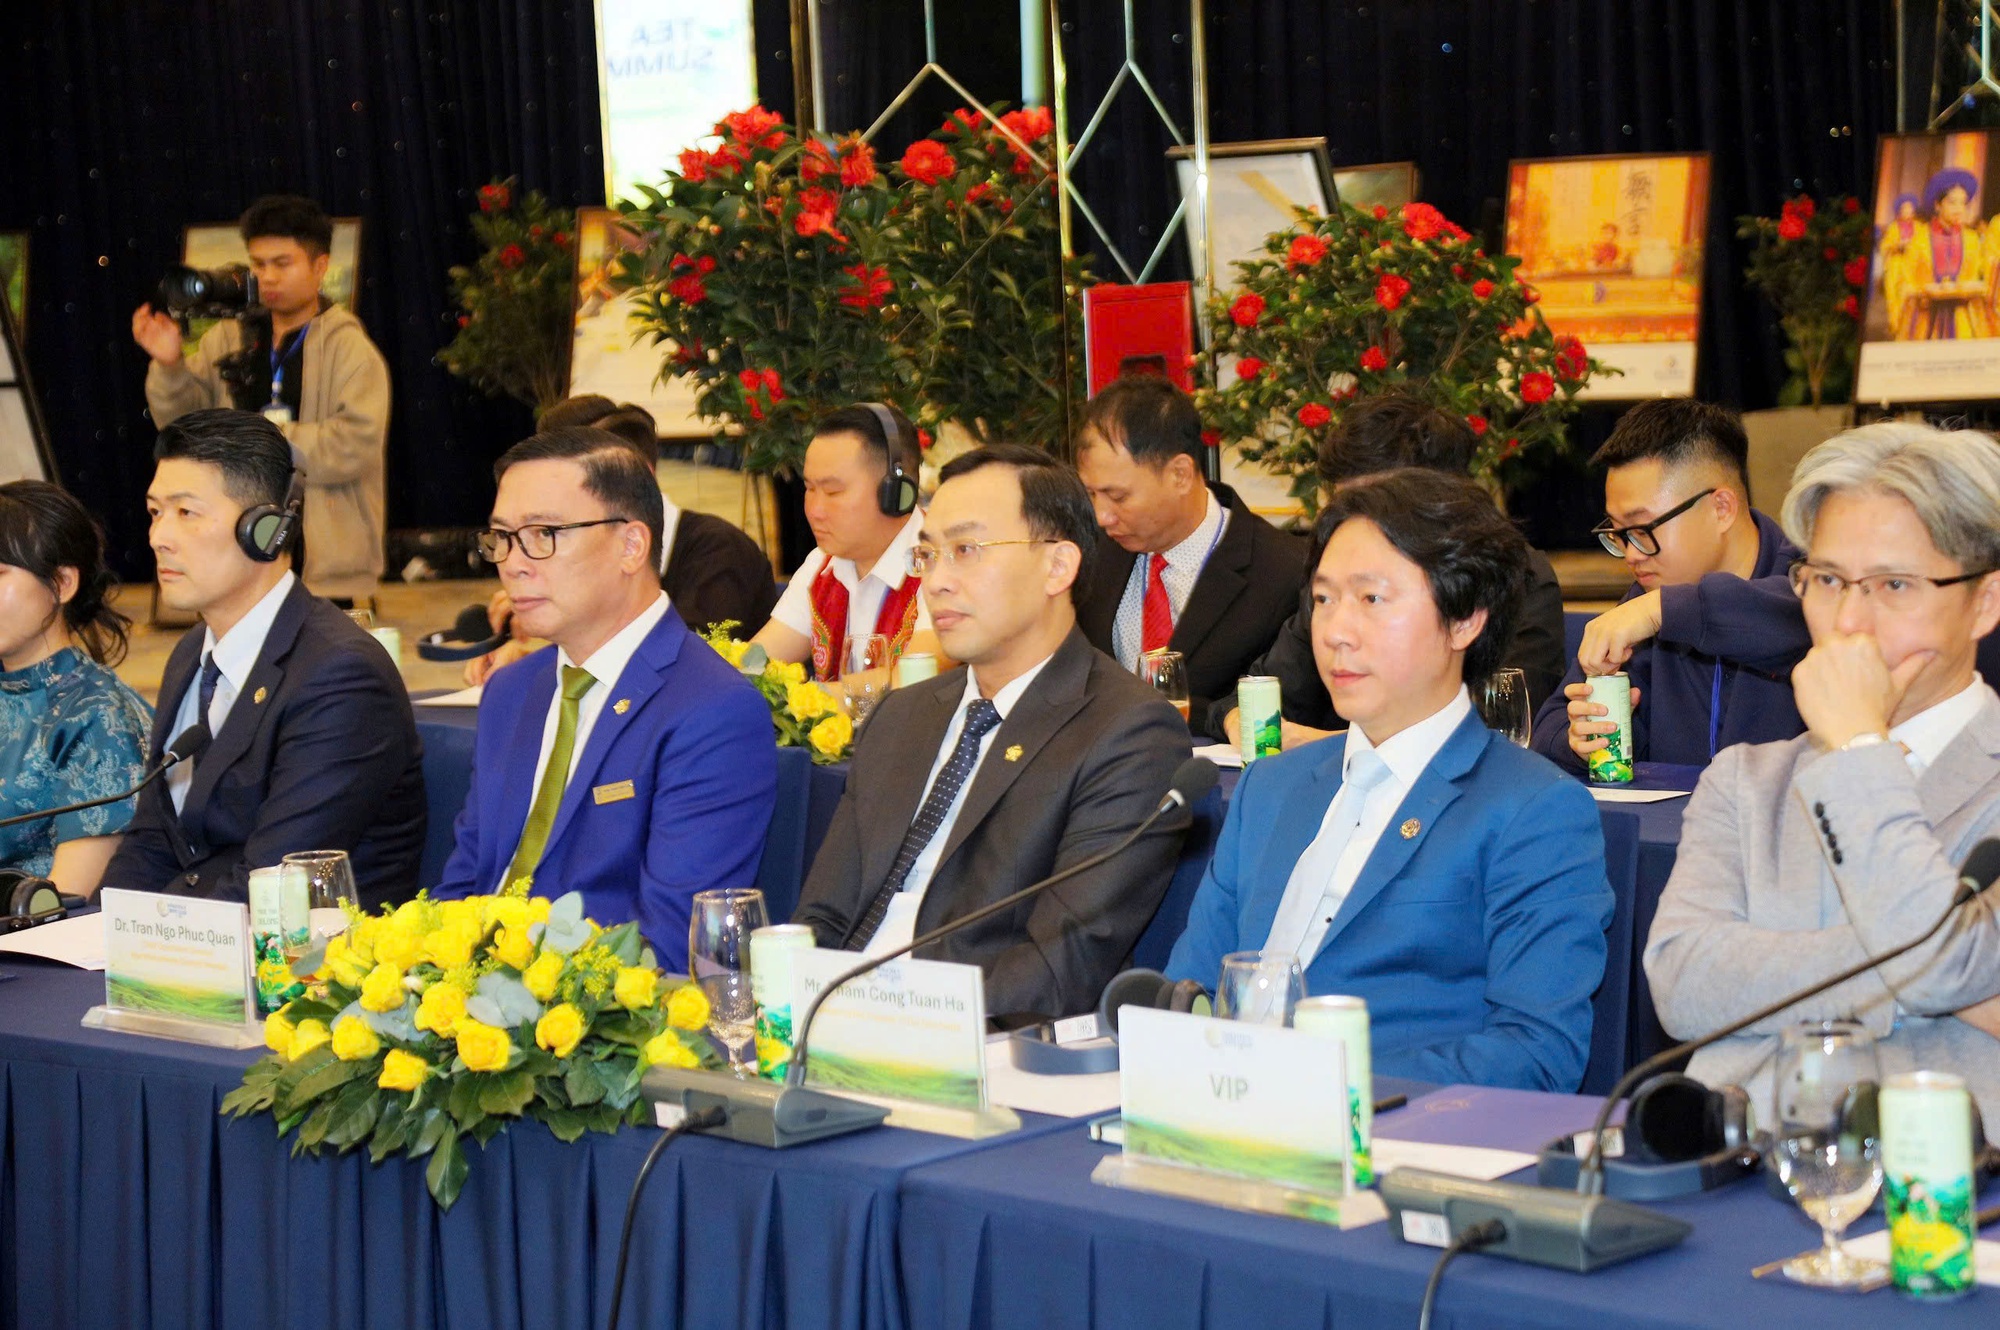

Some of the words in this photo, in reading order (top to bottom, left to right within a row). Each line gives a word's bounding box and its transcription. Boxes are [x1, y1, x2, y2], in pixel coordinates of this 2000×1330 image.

[114, 917, 129, 933] Dr.
[131, 919, 153, 935] Tran
[155, 923, 176, 940] Ngo
[178, 926, 204, 942] Phuc
[207, 929, 236, 946] Quan
[804, 977, 822, 994] Mr
[869, 985, 905, 1008] Cong
[908, 990, 941, 1010] Tuan
[944, 996, 965, 1012] Ha
[1208, 1072, 1249, 1102] VIP
